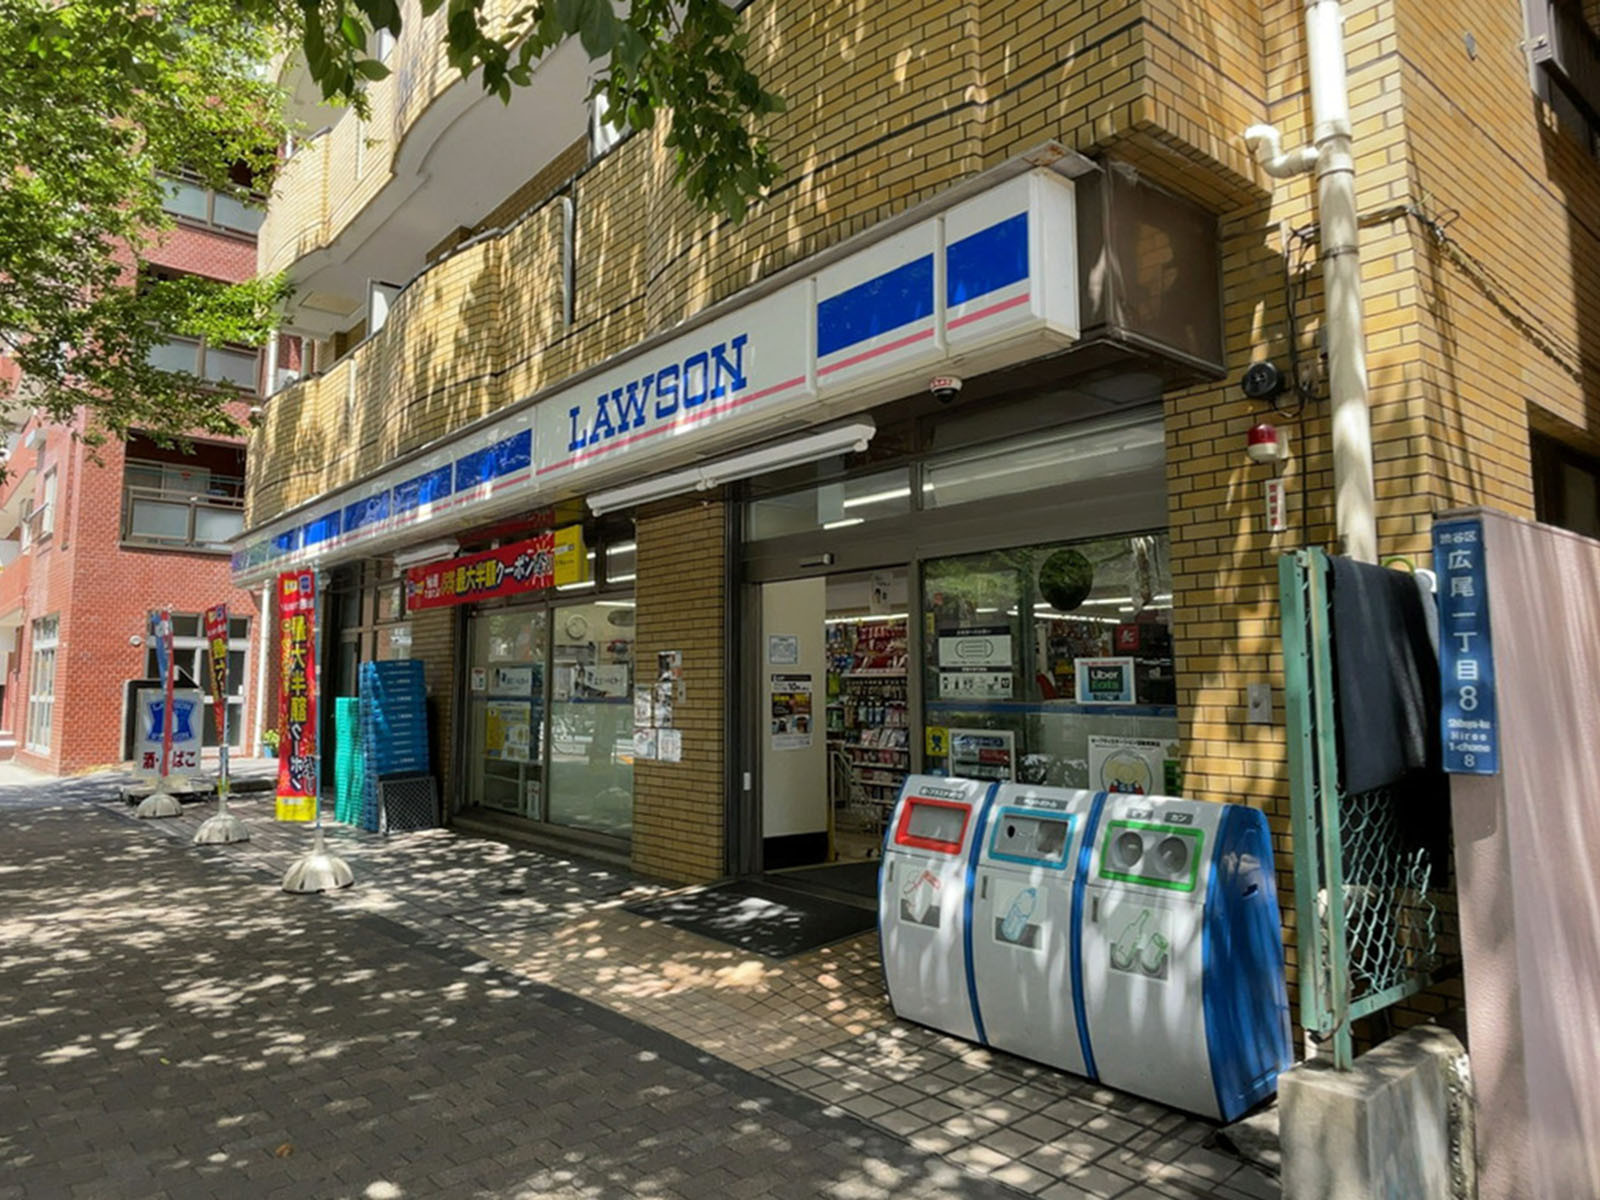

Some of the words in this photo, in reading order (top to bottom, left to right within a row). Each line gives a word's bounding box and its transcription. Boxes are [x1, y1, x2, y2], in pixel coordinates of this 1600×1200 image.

[568, 333, 748, 452] LAWSON
[1439, 530, 1477, 545] 渋谷区
[1090, 669, 1119, 680] Uber
[1464, 753, 1476, 768] 8
